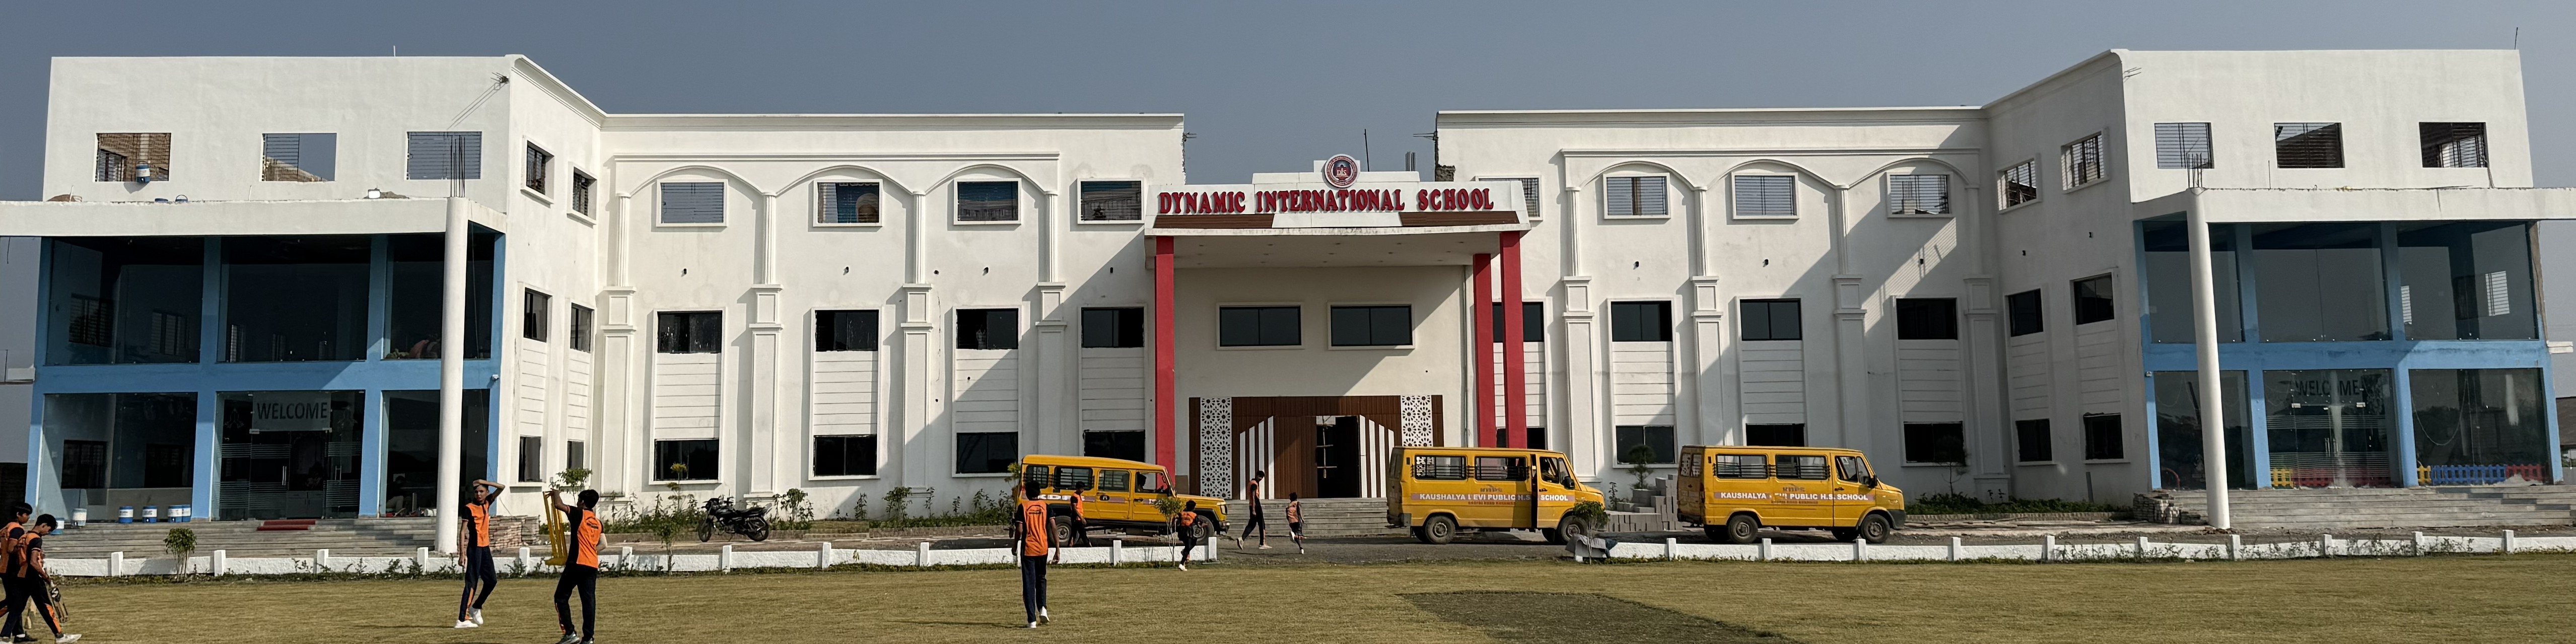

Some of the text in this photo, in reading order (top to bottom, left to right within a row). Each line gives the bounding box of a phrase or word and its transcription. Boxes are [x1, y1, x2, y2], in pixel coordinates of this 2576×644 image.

[1158, 188, 1494, 213] DYNAMIC INTERNATIONAL SCHOOL
[2295, 380, 2360, 396] WELCME
[256, 402, 328, 419] WELCOME
